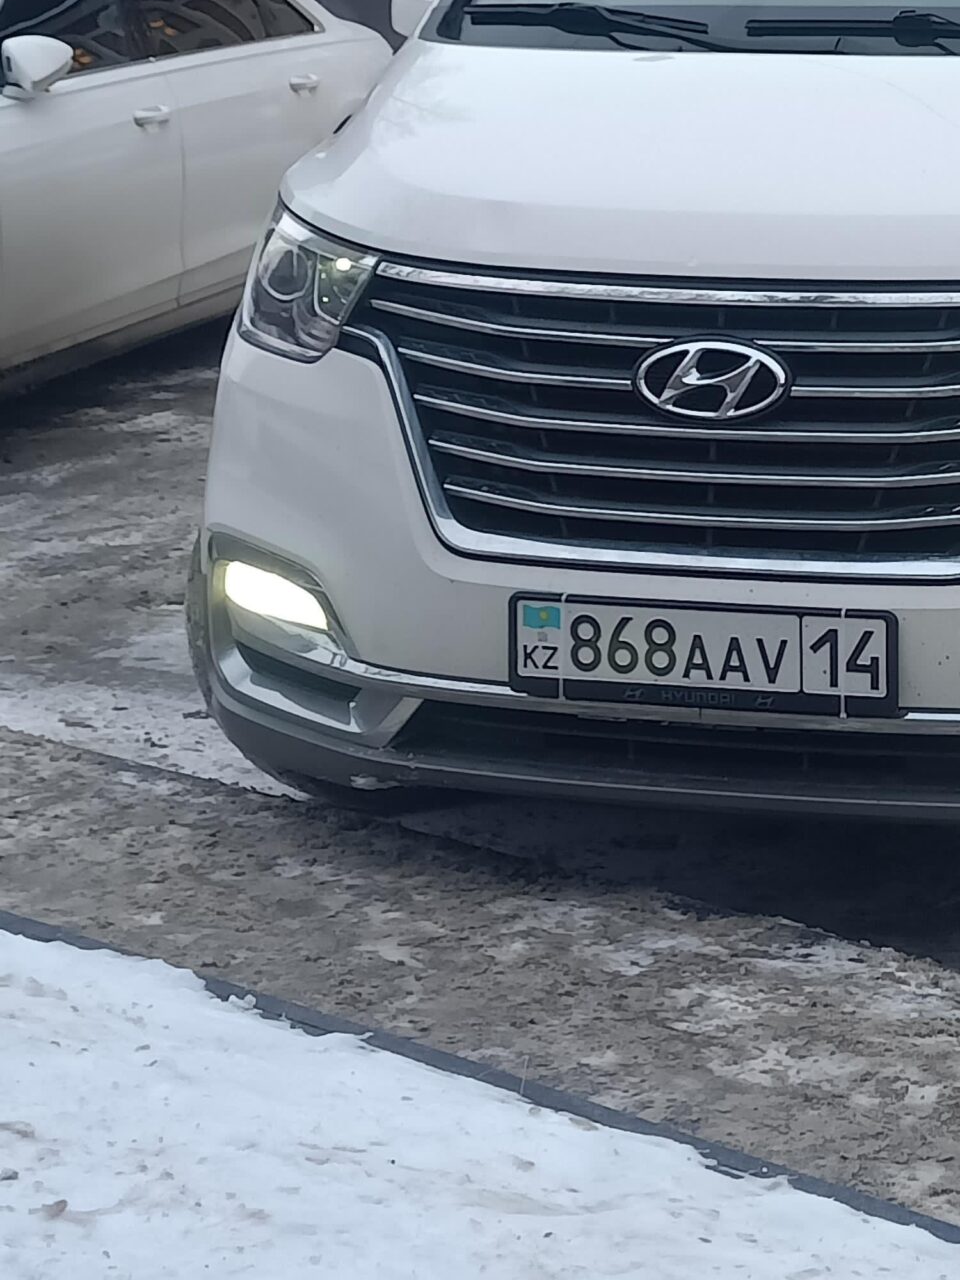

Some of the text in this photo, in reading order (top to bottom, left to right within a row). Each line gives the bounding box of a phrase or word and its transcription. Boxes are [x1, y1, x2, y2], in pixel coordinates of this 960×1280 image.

[523, 644, 559, 670] KZ
[570, 614, 880, 691] 868AAV 14
[661, 690, 735, 705] HYUNDAI
